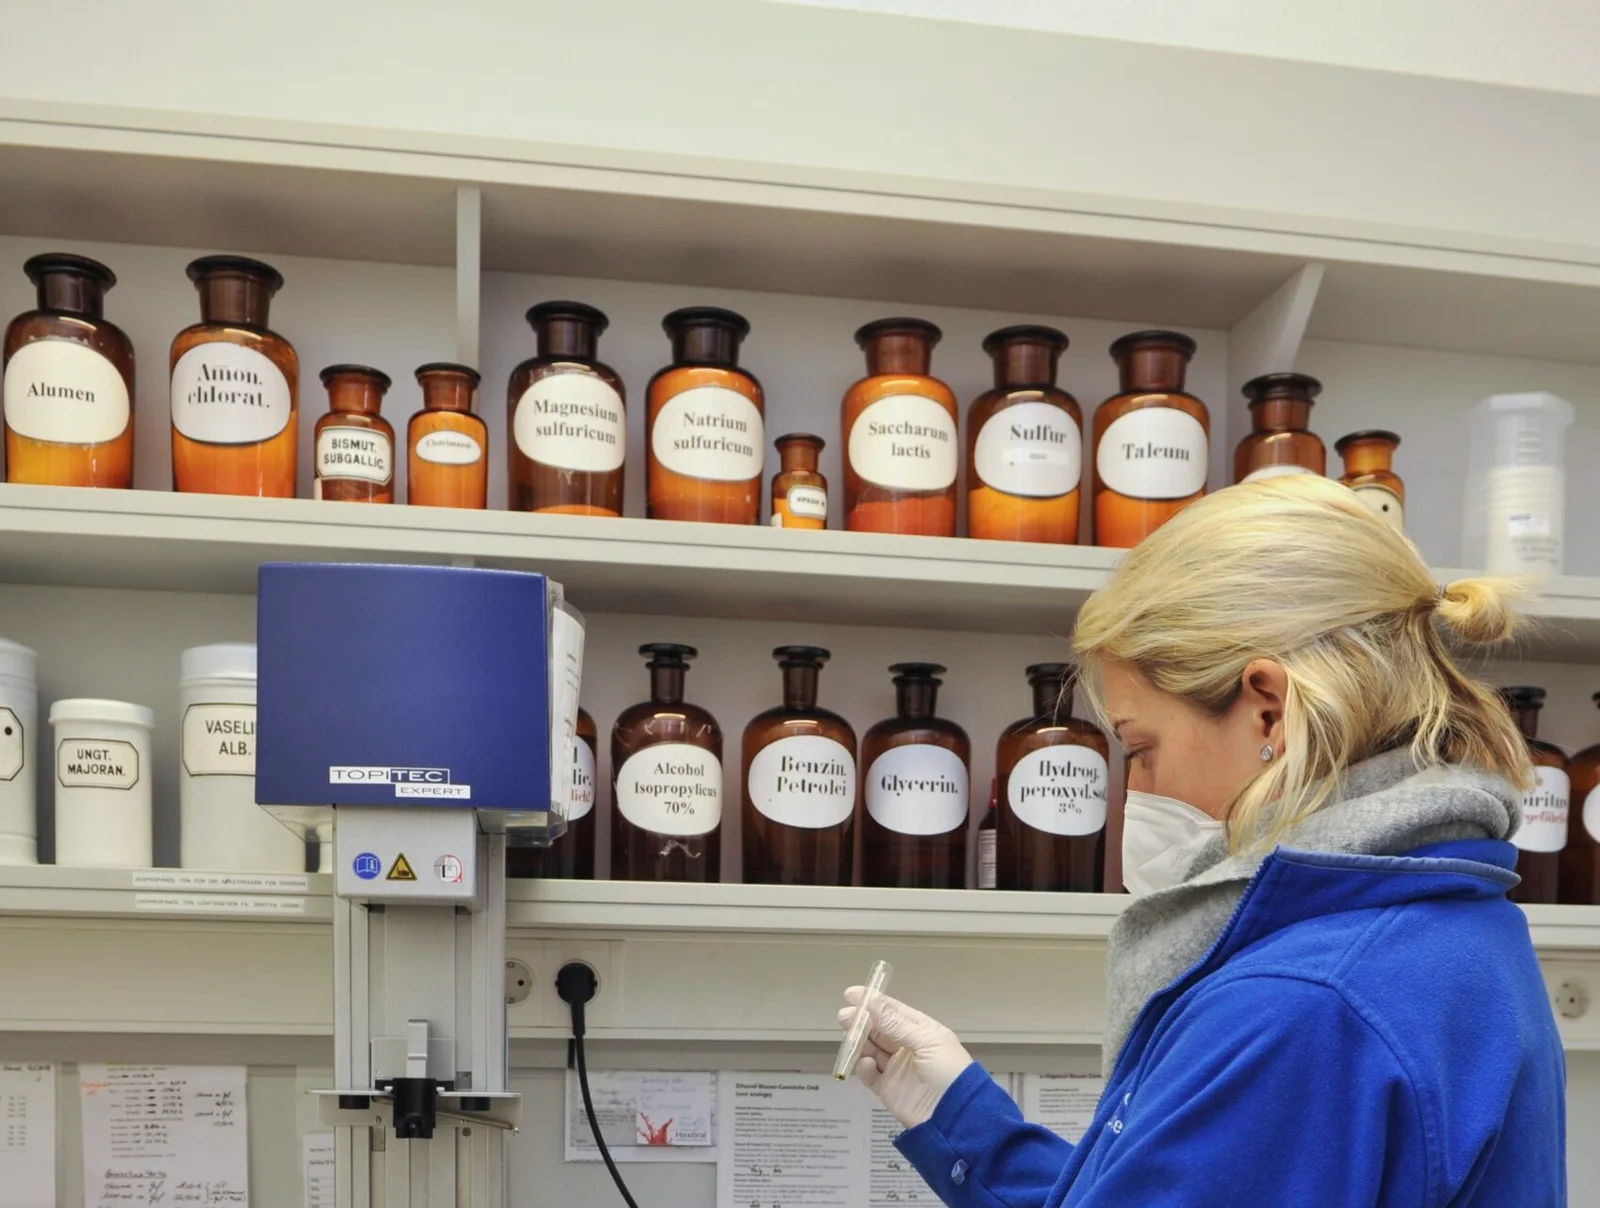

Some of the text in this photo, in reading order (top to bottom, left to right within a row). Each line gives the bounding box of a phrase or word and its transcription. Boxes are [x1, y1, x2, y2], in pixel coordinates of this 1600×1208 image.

[27, 381, 95, 402] Alumen
[188, 386, 270, 408] chlorat.
[534, 399, 618, 423] Magnesium
[683, 411, 747, 432] Natrium
[536, 422, 616, 445] sulfuricum
[868, 420, 948, 441] Saccharum
[1010, 424, 1067, 444] Sulfur
[331, 438, 377, 454] BISMUT.
[673, 434, 753, 457] sulfuricum
[891, 442, 931, 459] lactis
[1122, 442, 1190, 460] Talcum
[205, 720, 255, 735] VASELI
[77, 749, 111, 761] UNGT.
[219, 742, 252, 756] ALB.
[68, 764, 126, 776] MAJORAN.
[654, 762, 704, 776] Alcohol
[781, 755, 847, 776] Benzin.
[332, 769, 443, 782] TOPITEC
[400, 787, 464, 796] EXPERT
[634, 781, 717, 798] Isopropylicus
[777, 776, 847, 796] Petrolei
[881, 774, 958, 797] Glycerin.
[664, 801, 695, 815] 70%
[1523, 791, 1568, 808] iritus
